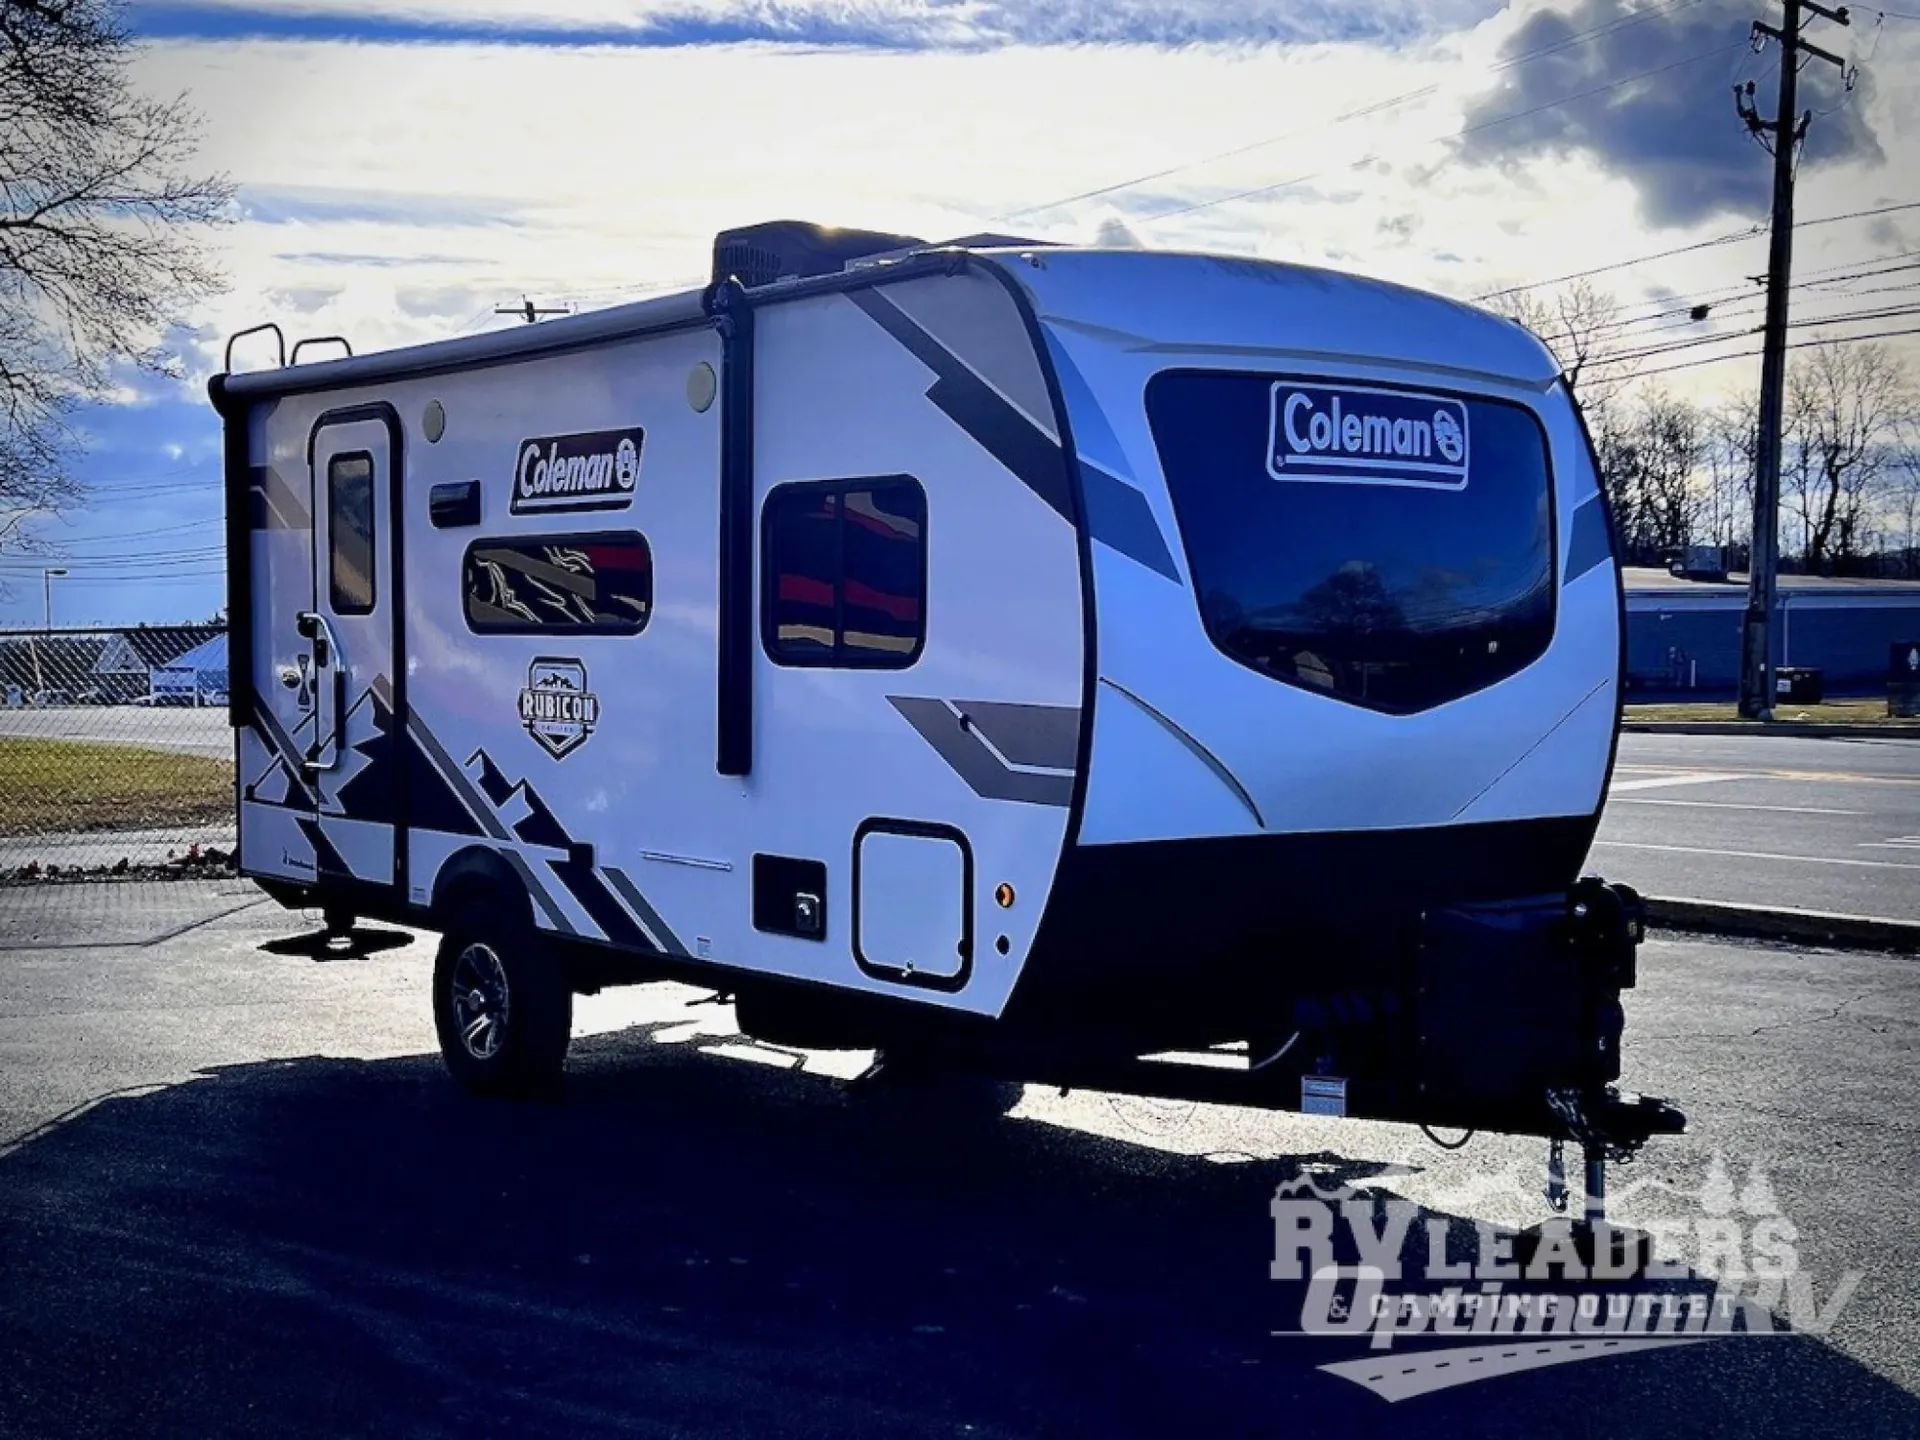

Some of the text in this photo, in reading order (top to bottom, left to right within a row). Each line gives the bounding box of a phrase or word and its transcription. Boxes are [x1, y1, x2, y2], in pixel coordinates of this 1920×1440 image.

[1284, 392, 1431, 457] Coleman
[520, 442, 614, 498] Coleman
[522, 691, 595, 721] RUBICON
